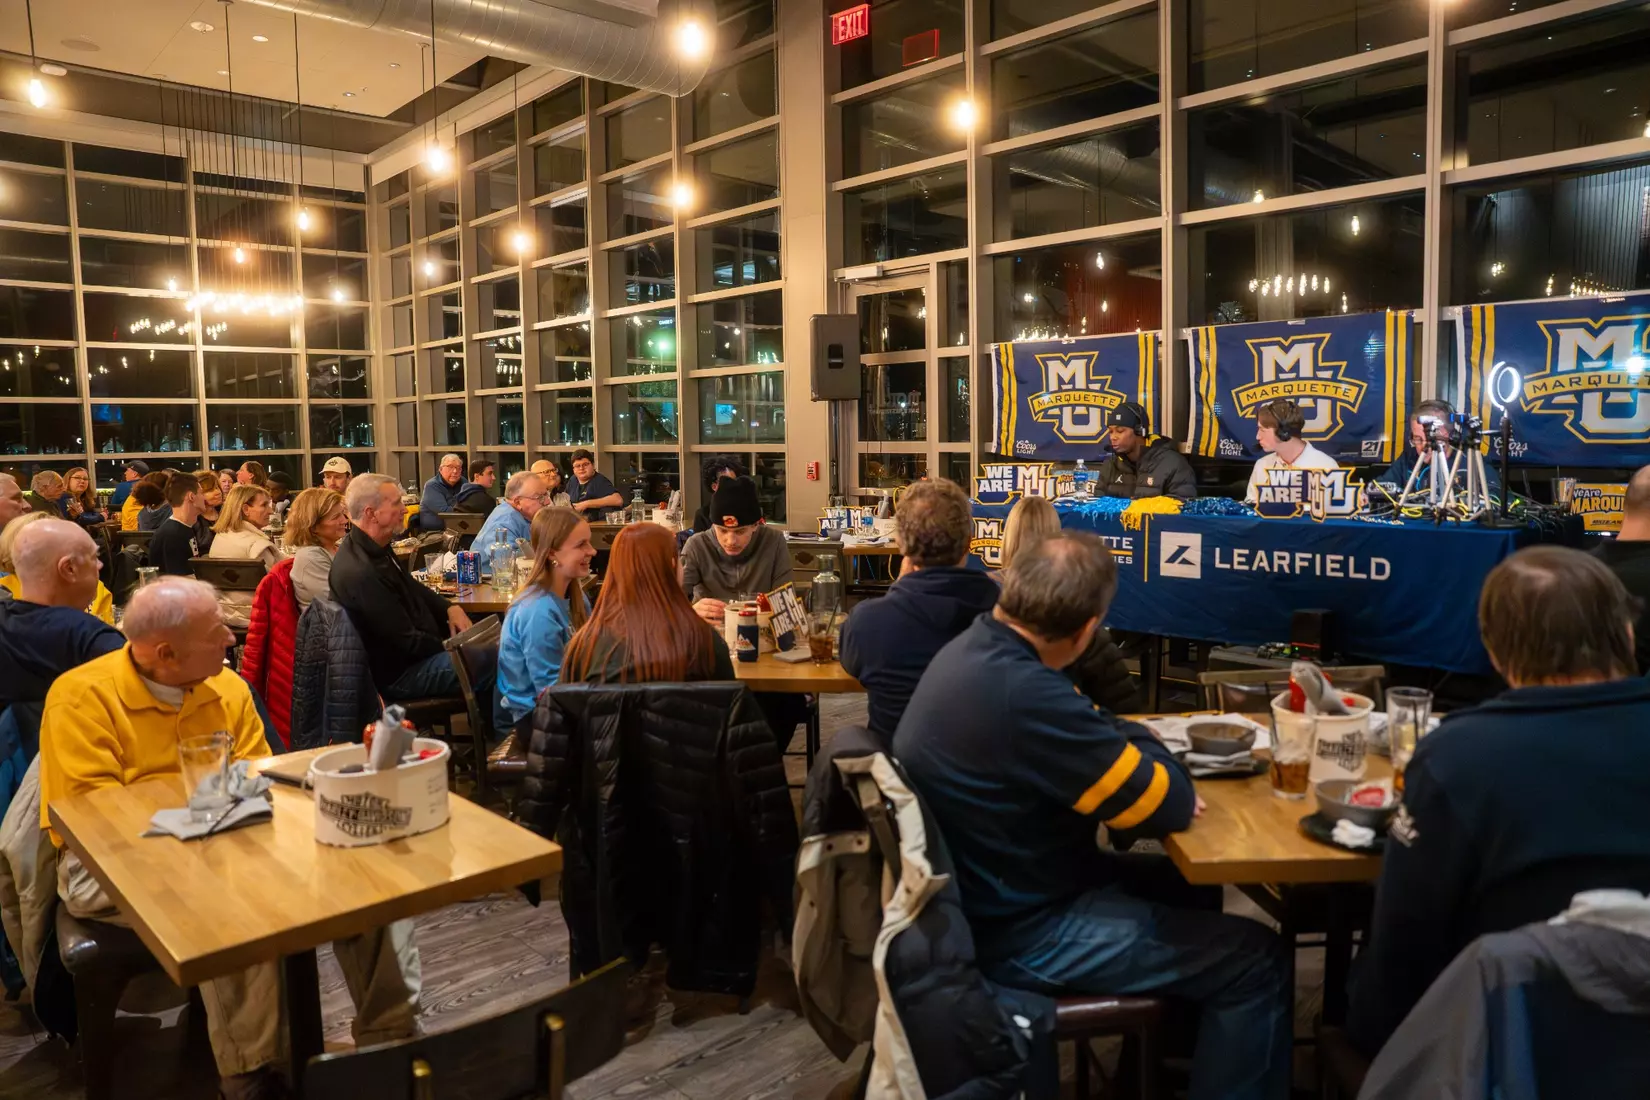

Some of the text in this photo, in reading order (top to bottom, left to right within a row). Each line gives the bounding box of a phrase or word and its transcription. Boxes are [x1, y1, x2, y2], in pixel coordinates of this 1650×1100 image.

[838, 11, 864, 40] EXIT
[1246, 382, 1352, 402] MARQUETTE
[1037, 393, 1117, 409] MARQUETTE
[1220, 448, 1242, 456] LIGHT
[985, 465, 1013, 479] WE
[1268, 470, 1303, 486] WE
[978, 479, 1013, 493] ARE
[1259, 487, 1303, 503] ARE
[1214, 546, 1392, 581] LEARFIELD
